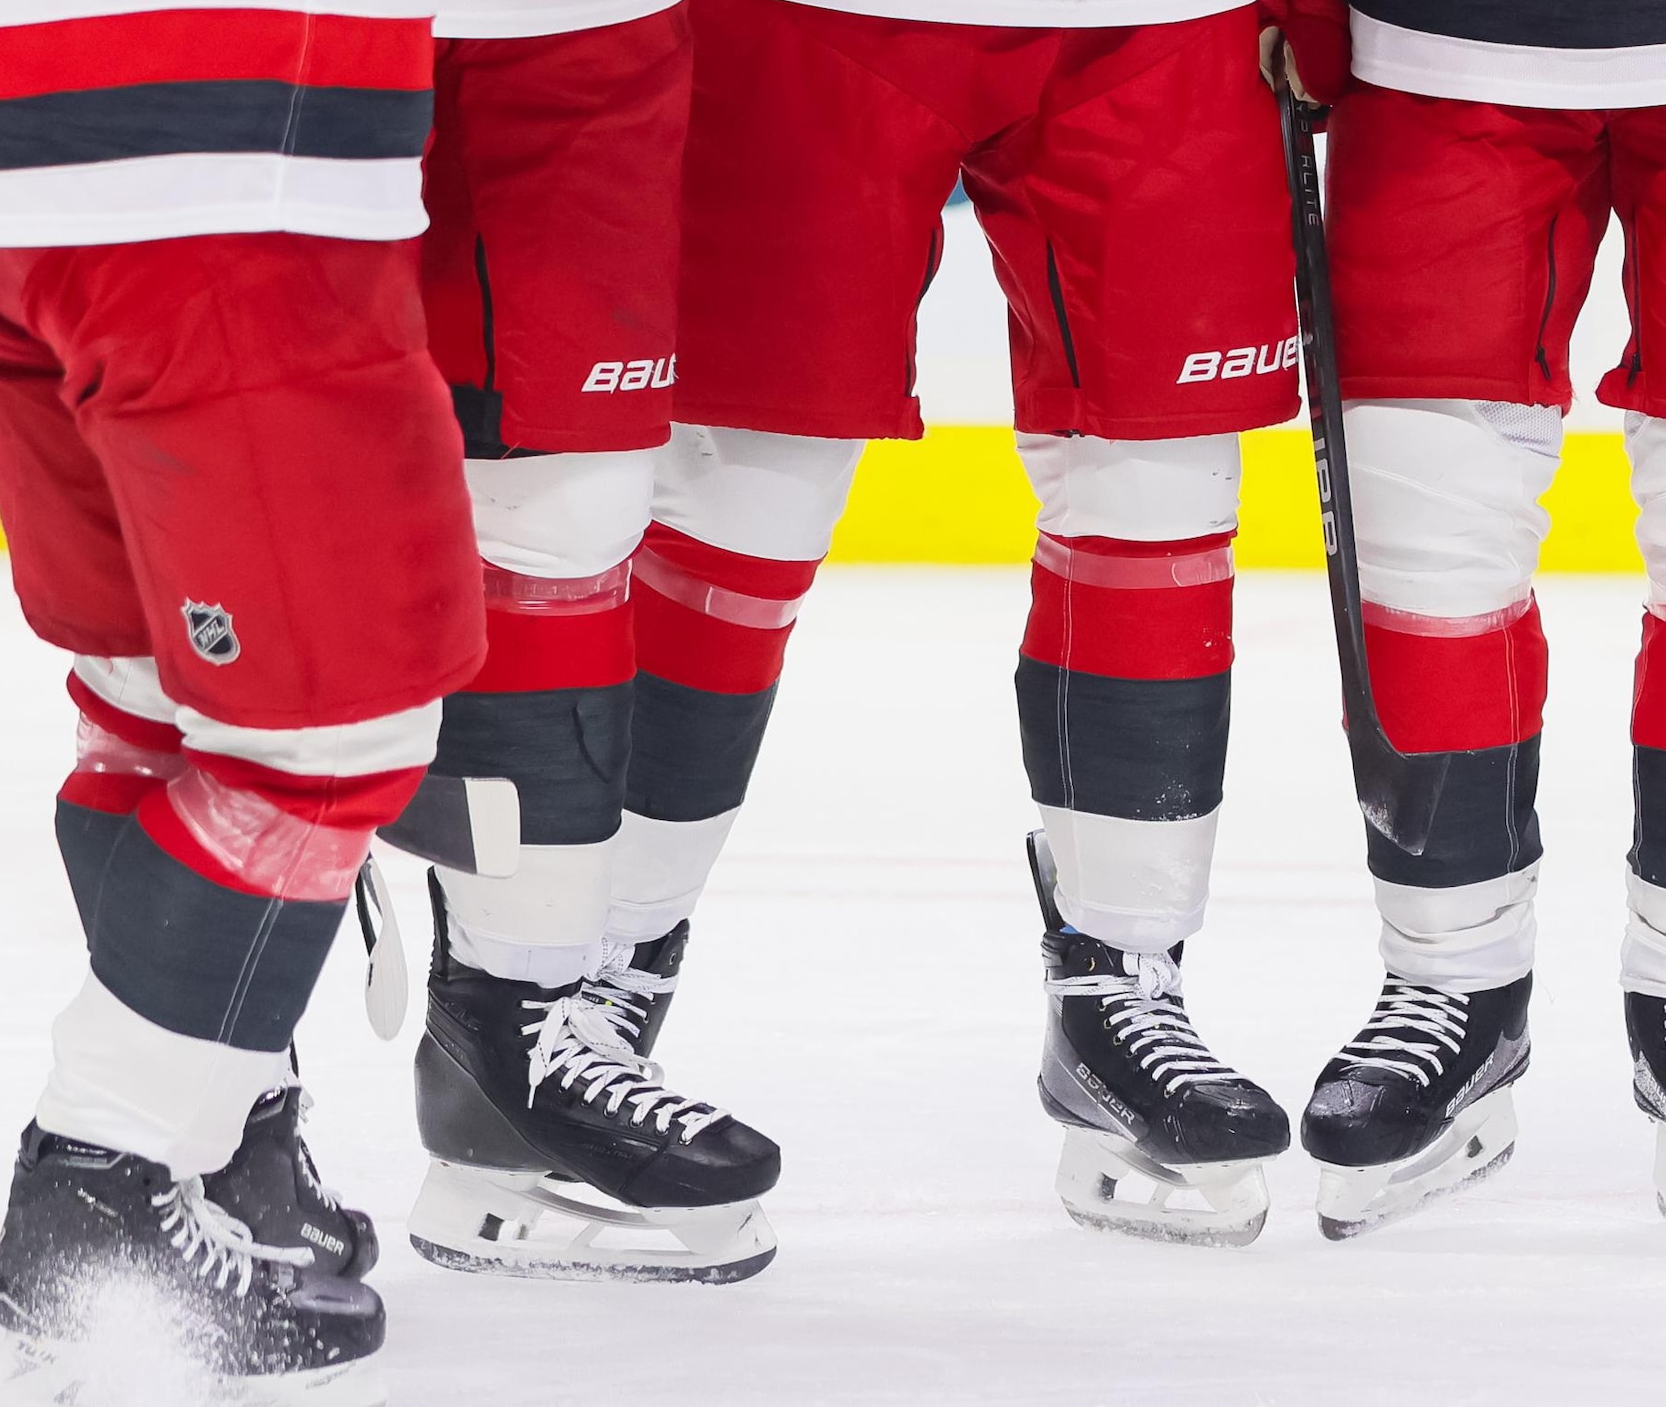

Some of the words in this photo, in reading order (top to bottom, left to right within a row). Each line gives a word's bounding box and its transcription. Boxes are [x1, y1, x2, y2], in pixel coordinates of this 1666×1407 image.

[1076, 1061, 1136, 1126] BAUER
[1444, 1050, 1496, 1118] BAUER
[301, 1222, 345, 1255] BAUER
